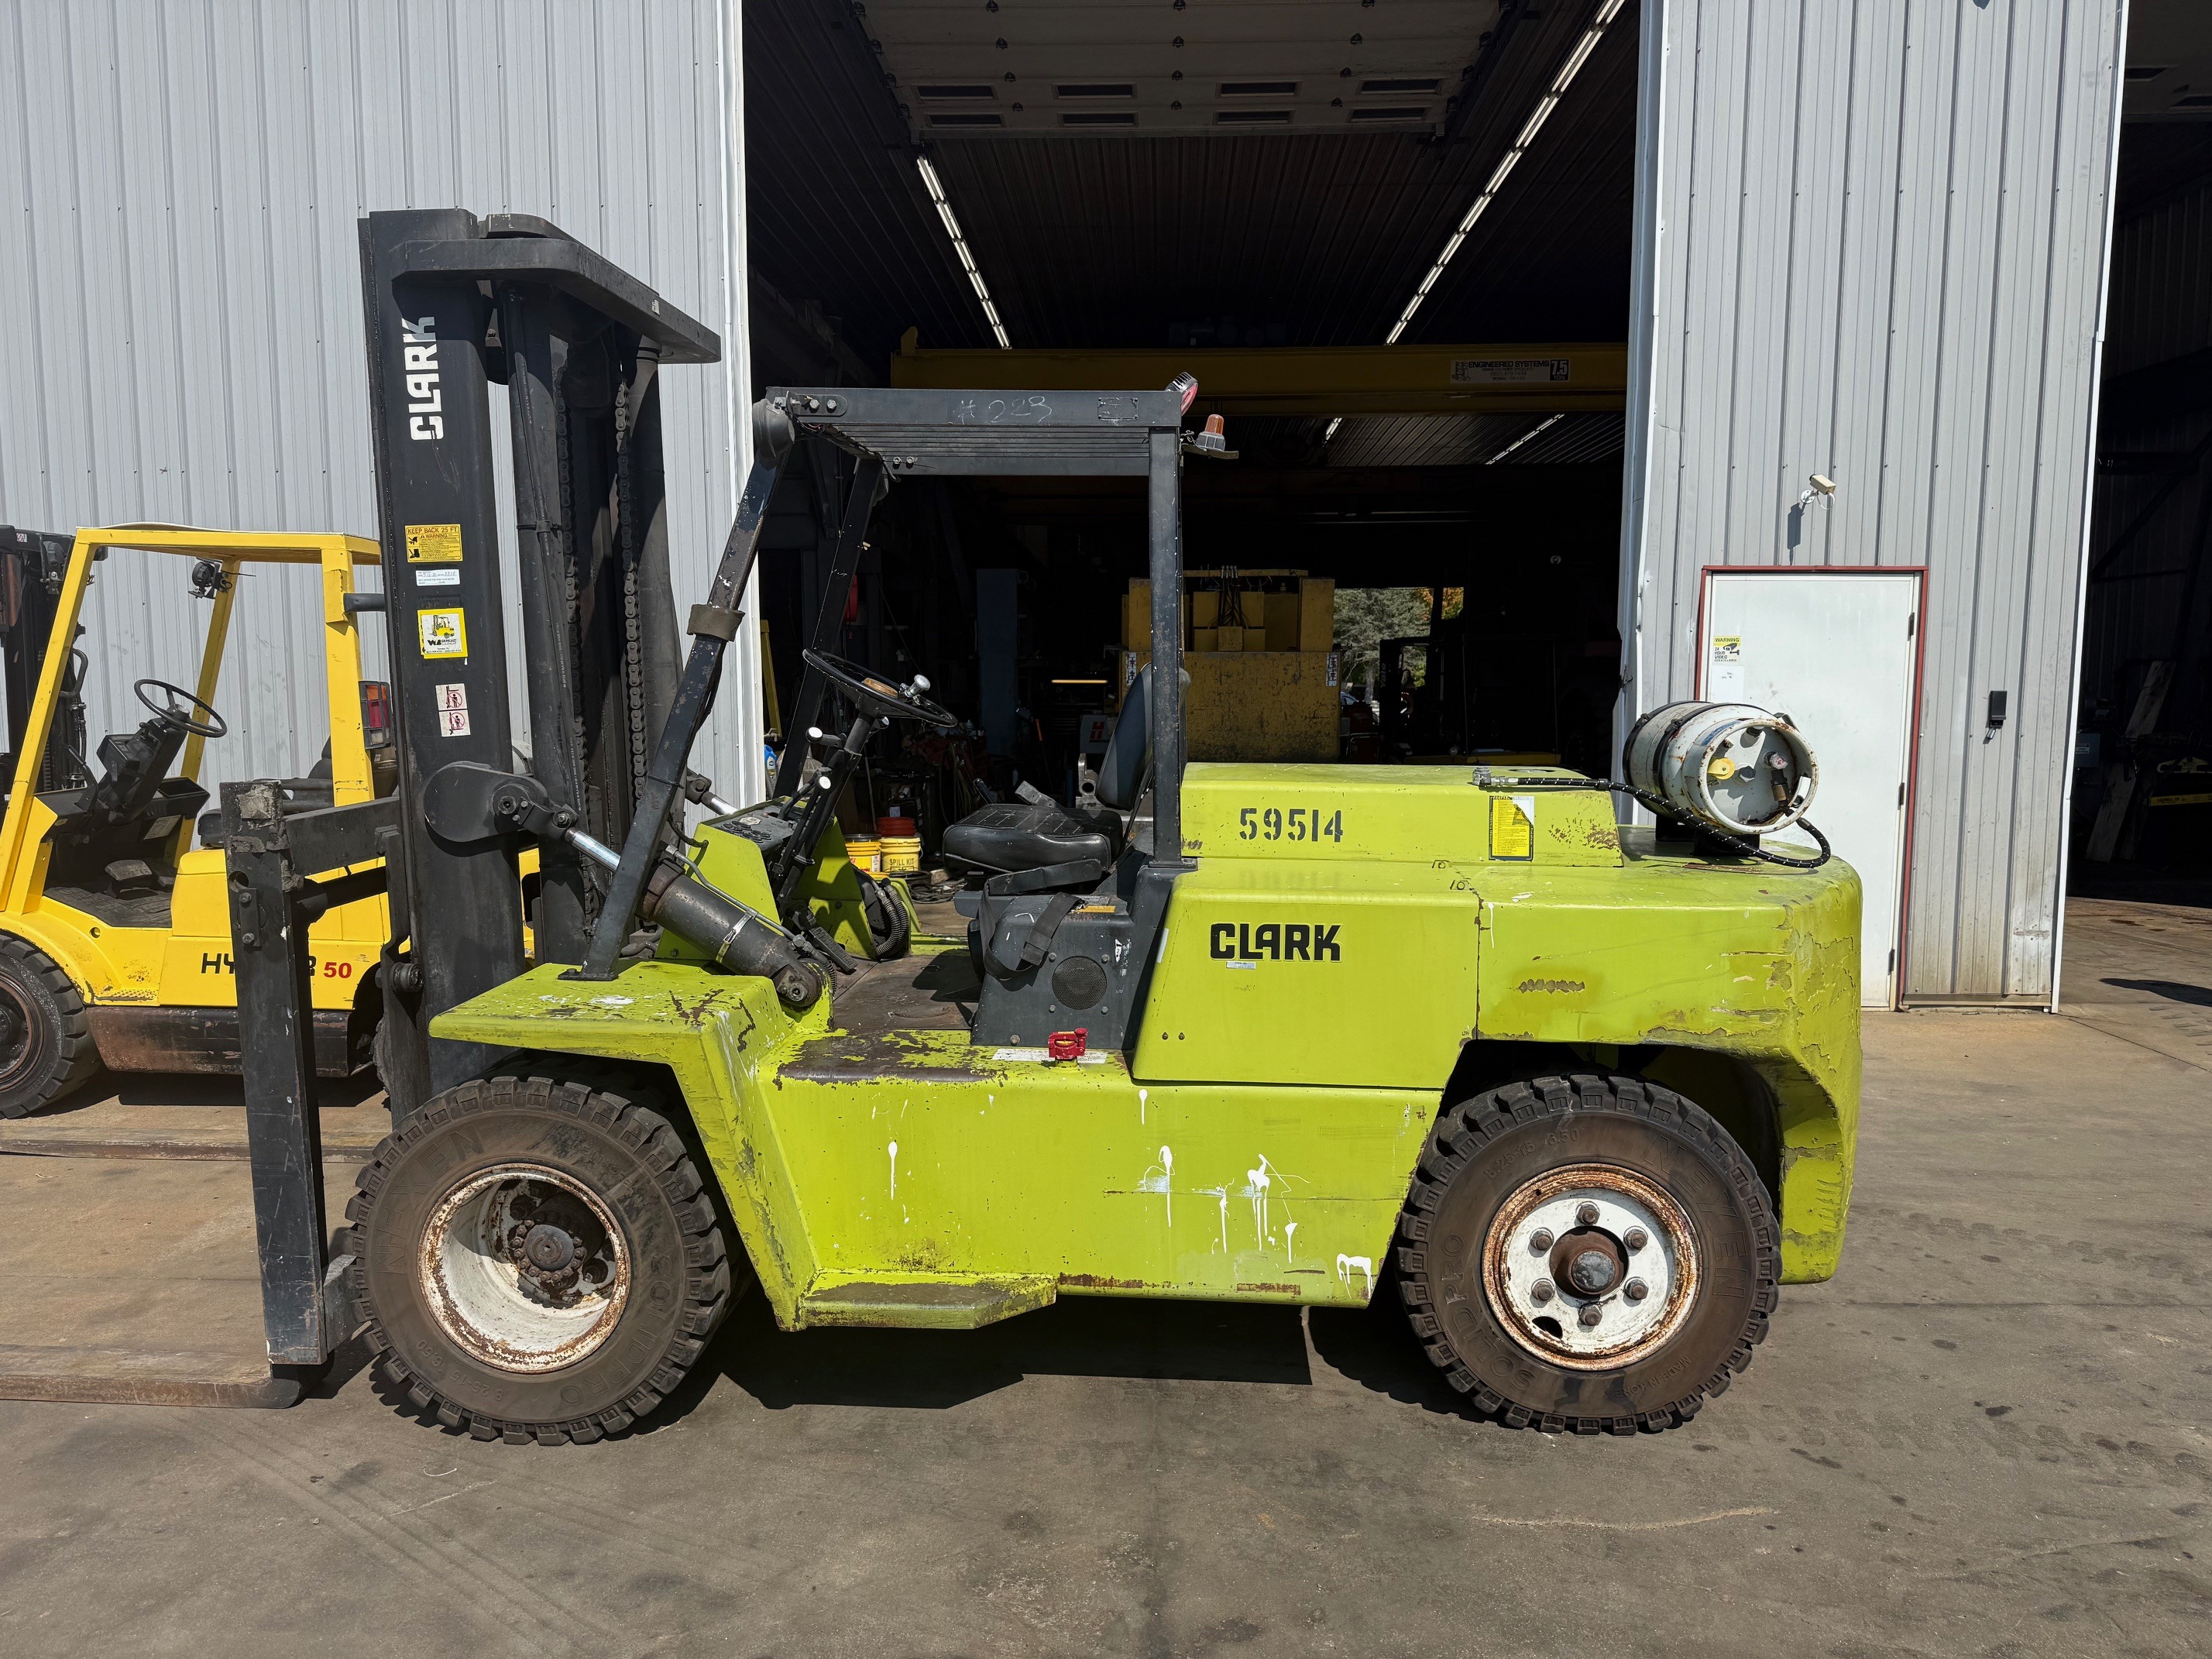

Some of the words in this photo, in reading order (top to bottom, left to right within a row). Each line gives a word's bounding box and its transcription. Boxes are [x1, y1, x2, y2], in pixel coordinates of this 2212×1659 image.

[401, 316, 444, 441] CLARK
[1551, 360, 1568, 376] 7.5
[1238, 807, 1344, 843] 59514
[1210, 922, 1341, 962] CLARK
[323, 961, 352, 979] 50
[374, 1125, 486, 1276] NEXEN
[1643, 1135, 1747, 1298] NEXEN
